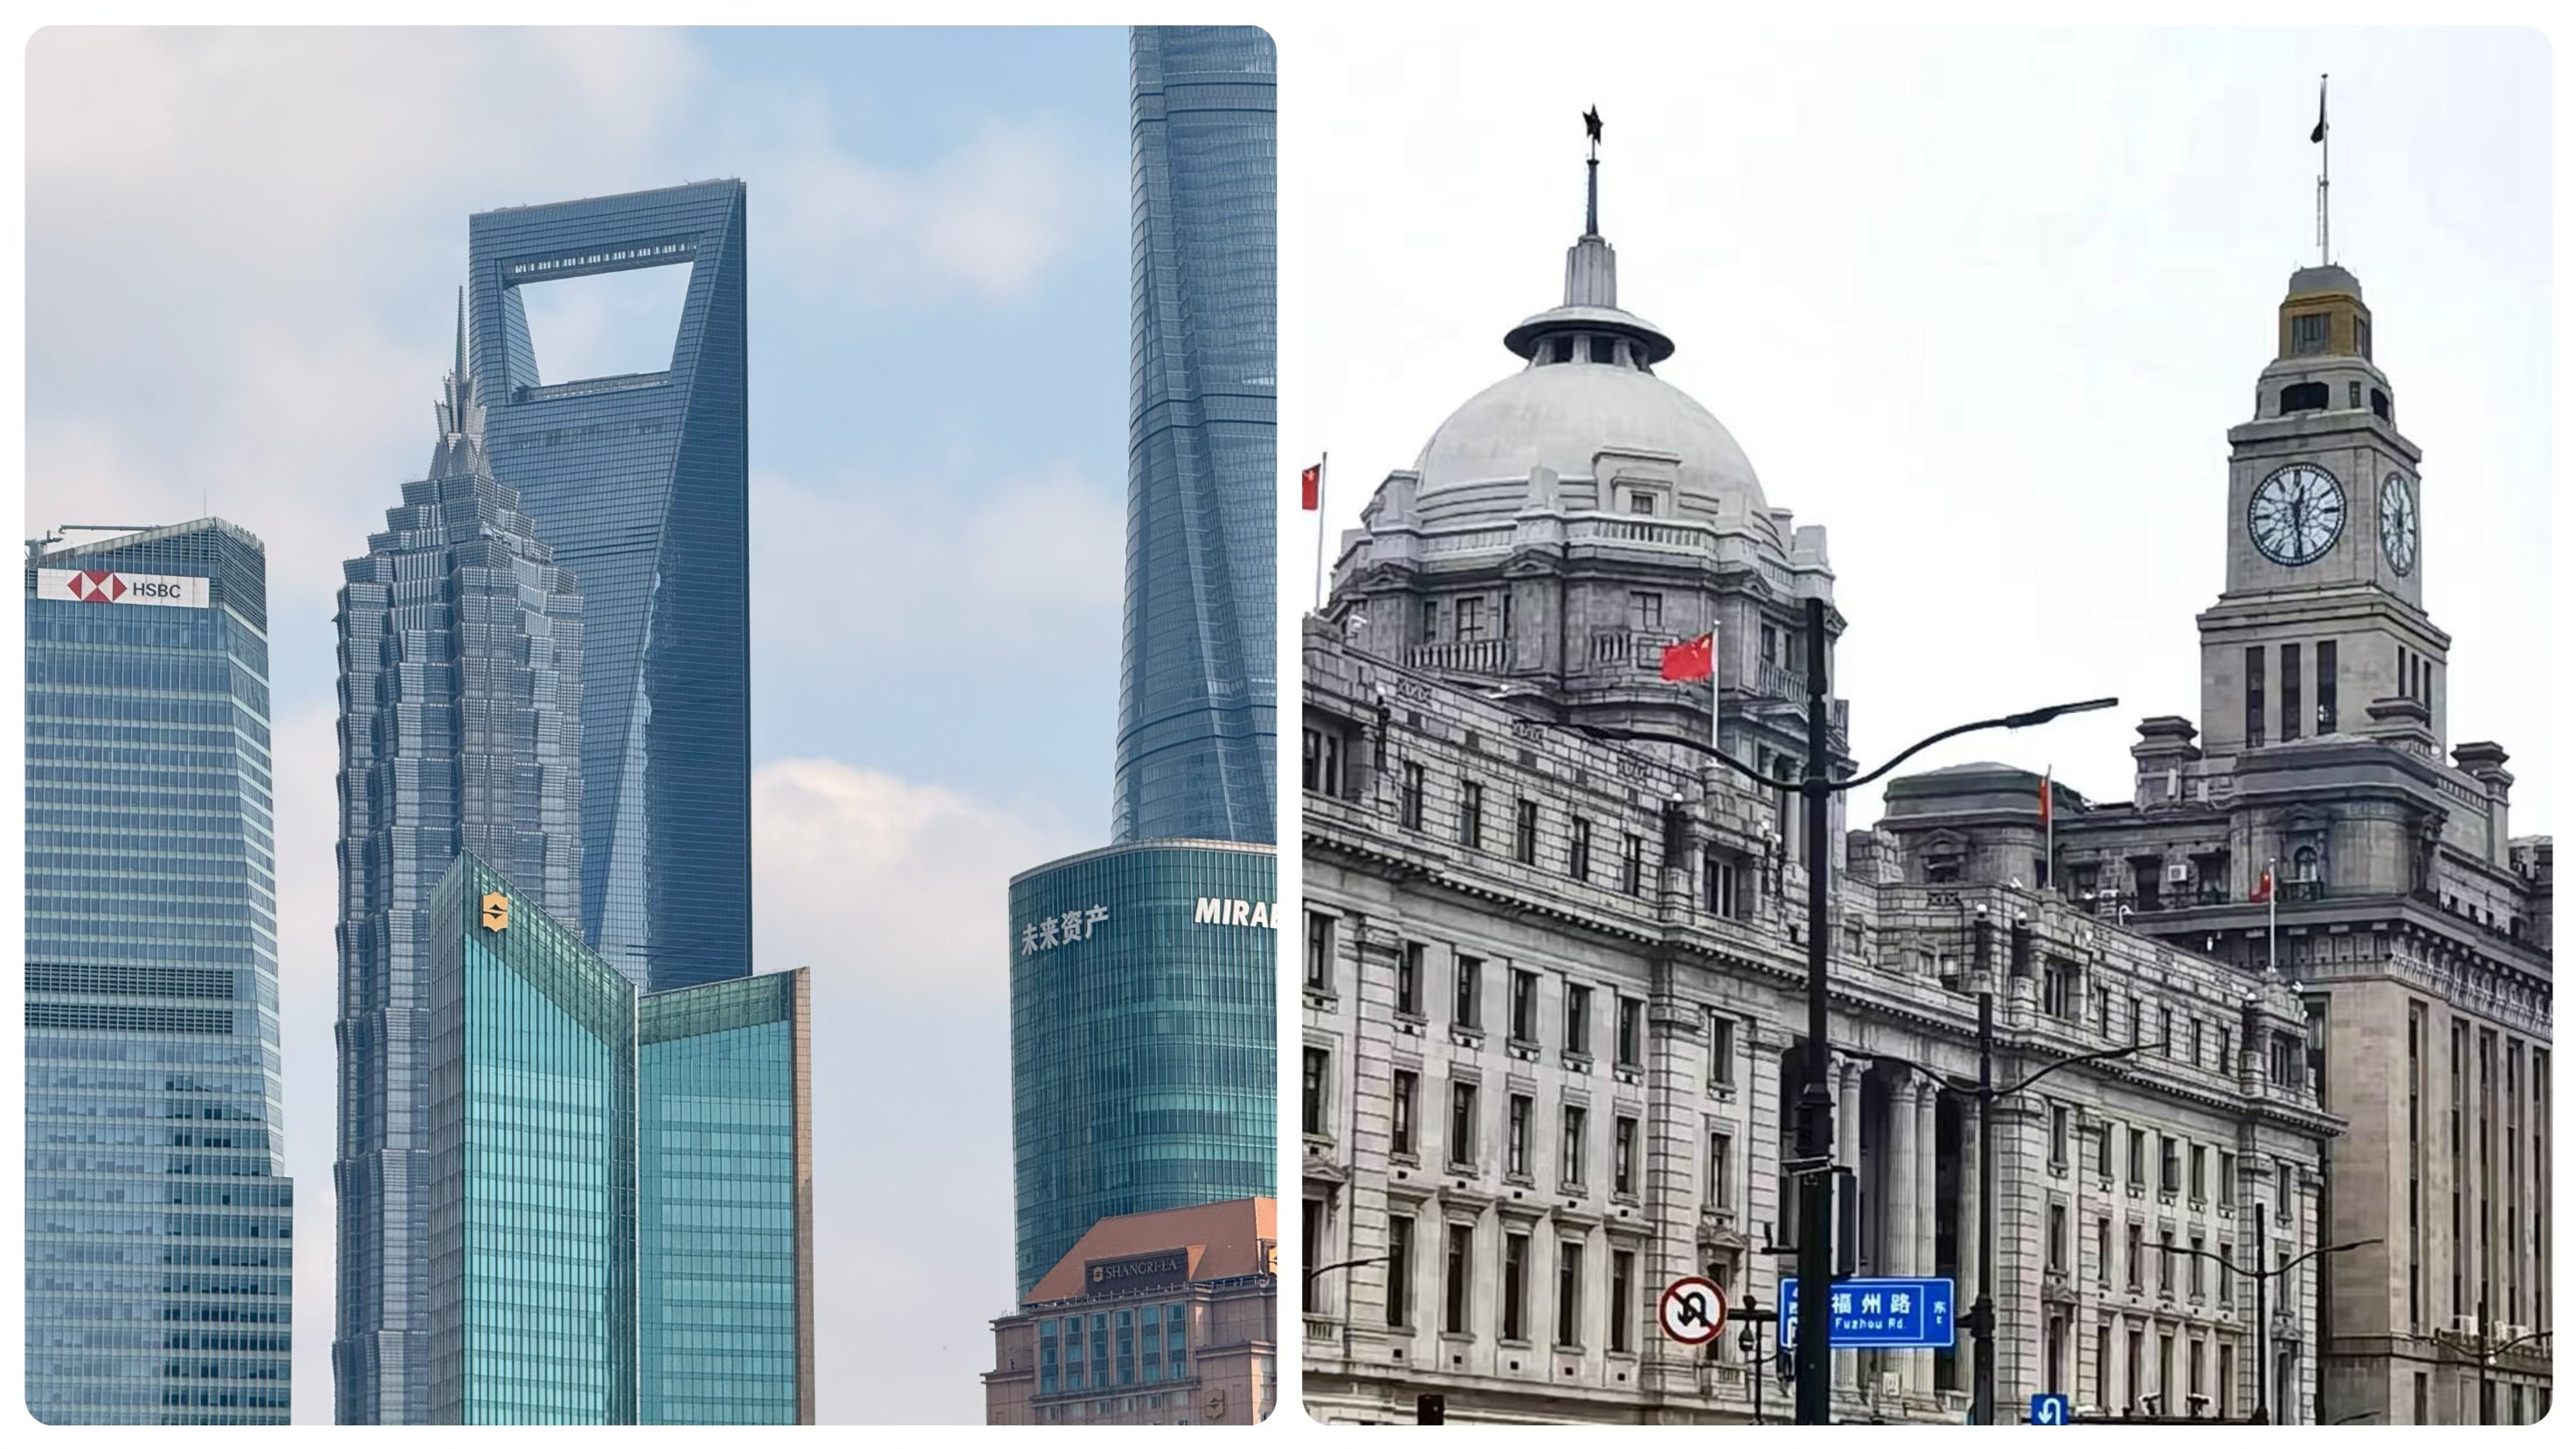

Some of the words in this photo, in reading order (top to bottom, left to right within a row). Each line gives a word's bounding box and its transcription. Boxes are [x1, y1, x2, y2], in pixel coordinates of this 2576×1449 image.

[132, 582, 182, 599] HSBC
[1021, 903, 1109, 956] 未来资产
[1104, 1258, 1178, 1279] SHANGRI-LA
[1832, 1293, 1911, 1314] 福州路
[1934, 1300, 1947, 1314] 东
[1834, 1317, 1883, 1330] Fuzhou
